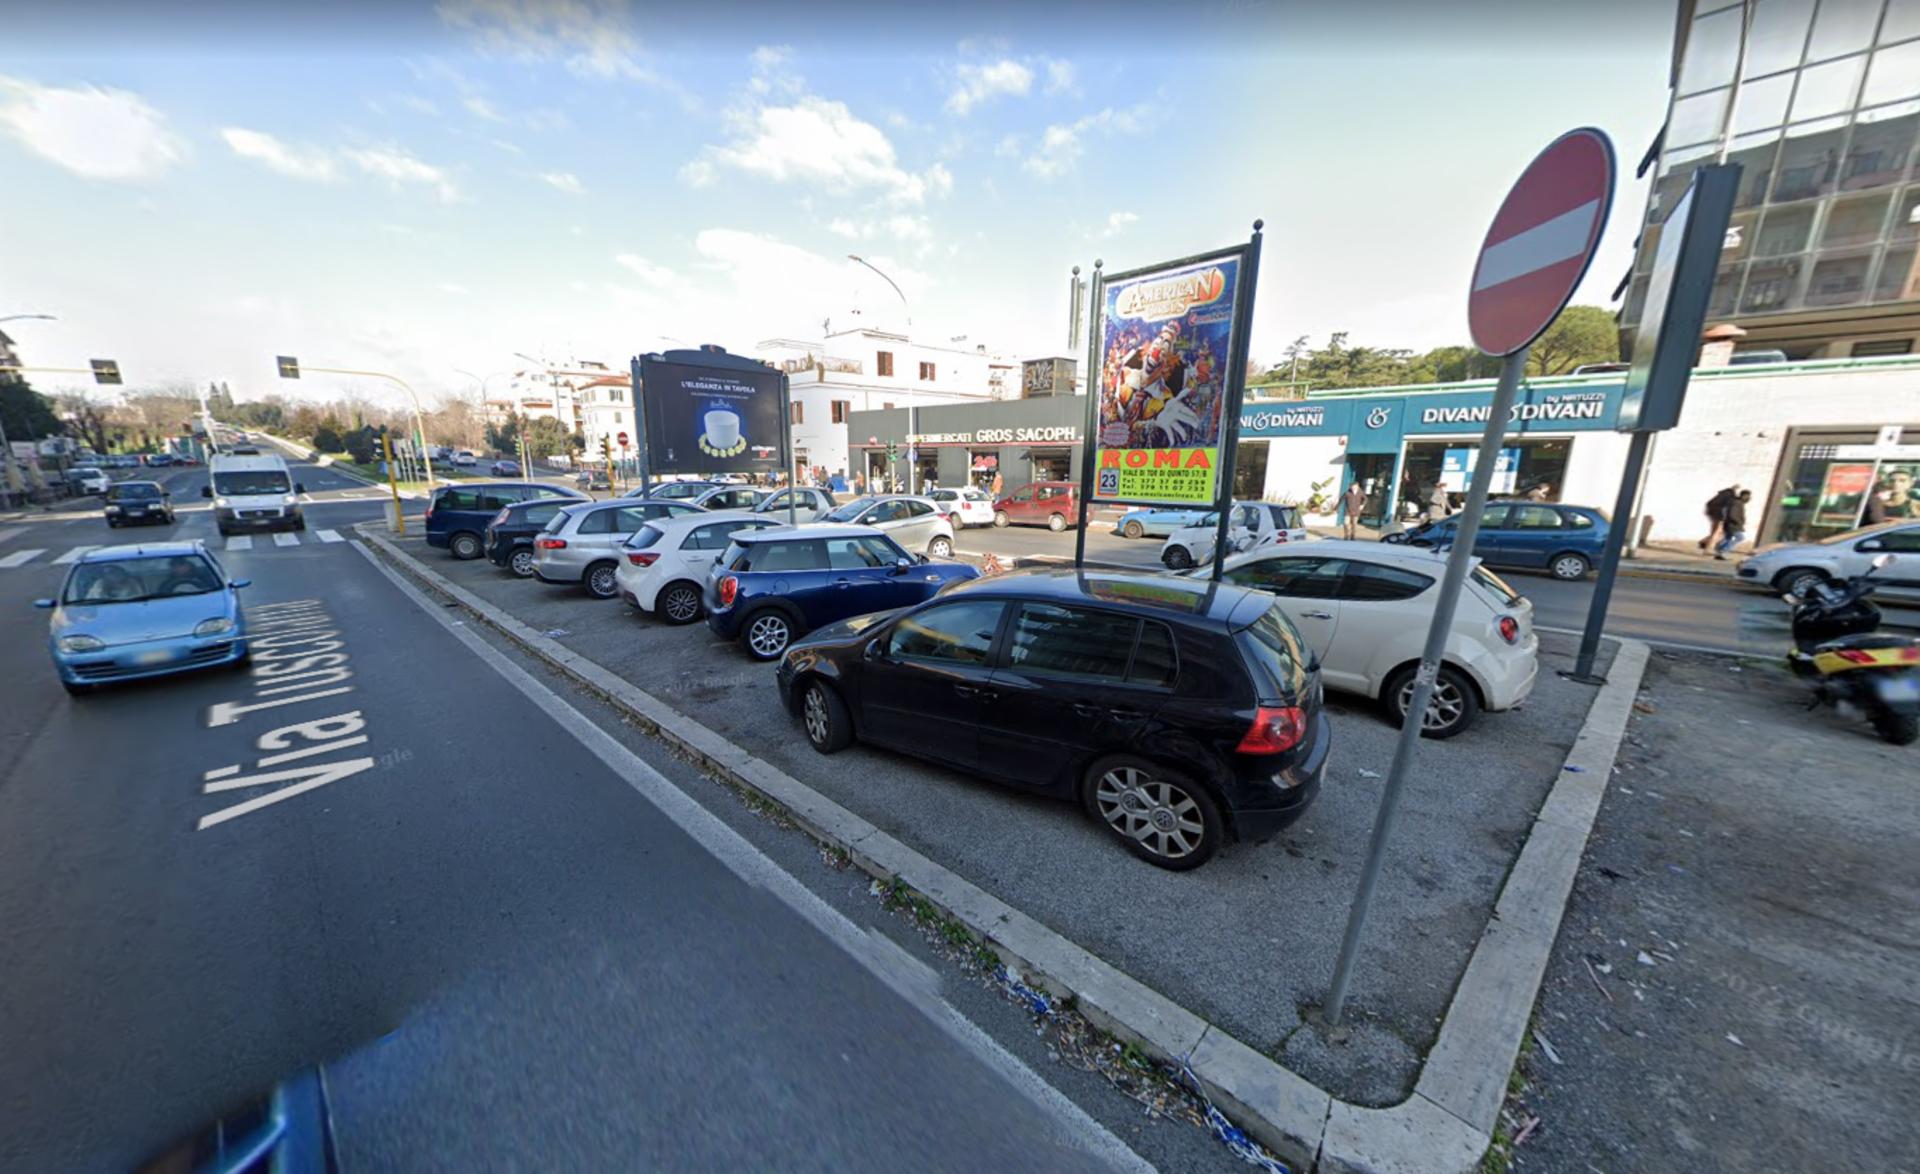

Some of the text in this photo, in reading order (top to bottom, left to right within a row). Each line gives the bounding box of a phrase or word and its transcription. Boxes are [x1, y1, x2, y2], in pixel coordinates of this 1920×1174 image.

[1124, 268, 1218, 313] AMERICAN
[681, 381, 723, 391] L'ELEGANZA
[732, 385, 756, 394] TAVOLA
[1423, 406, 1492, 423] DIVANI
[1521, 401, 1603, 420] DIVANI
[905, 426, 1076, 443] SPERMERCATI GROS SACOPH
[1102, 449, 1211, 468] ROMA
[1101, 474, 1117, 488] 23
[1122, 469, 1138, 477] VIALE
[1140, 469, 1146, 477] DI
[1167, 470, 1190, 478] QUINTO
[197, 710, 374, 831] Via
